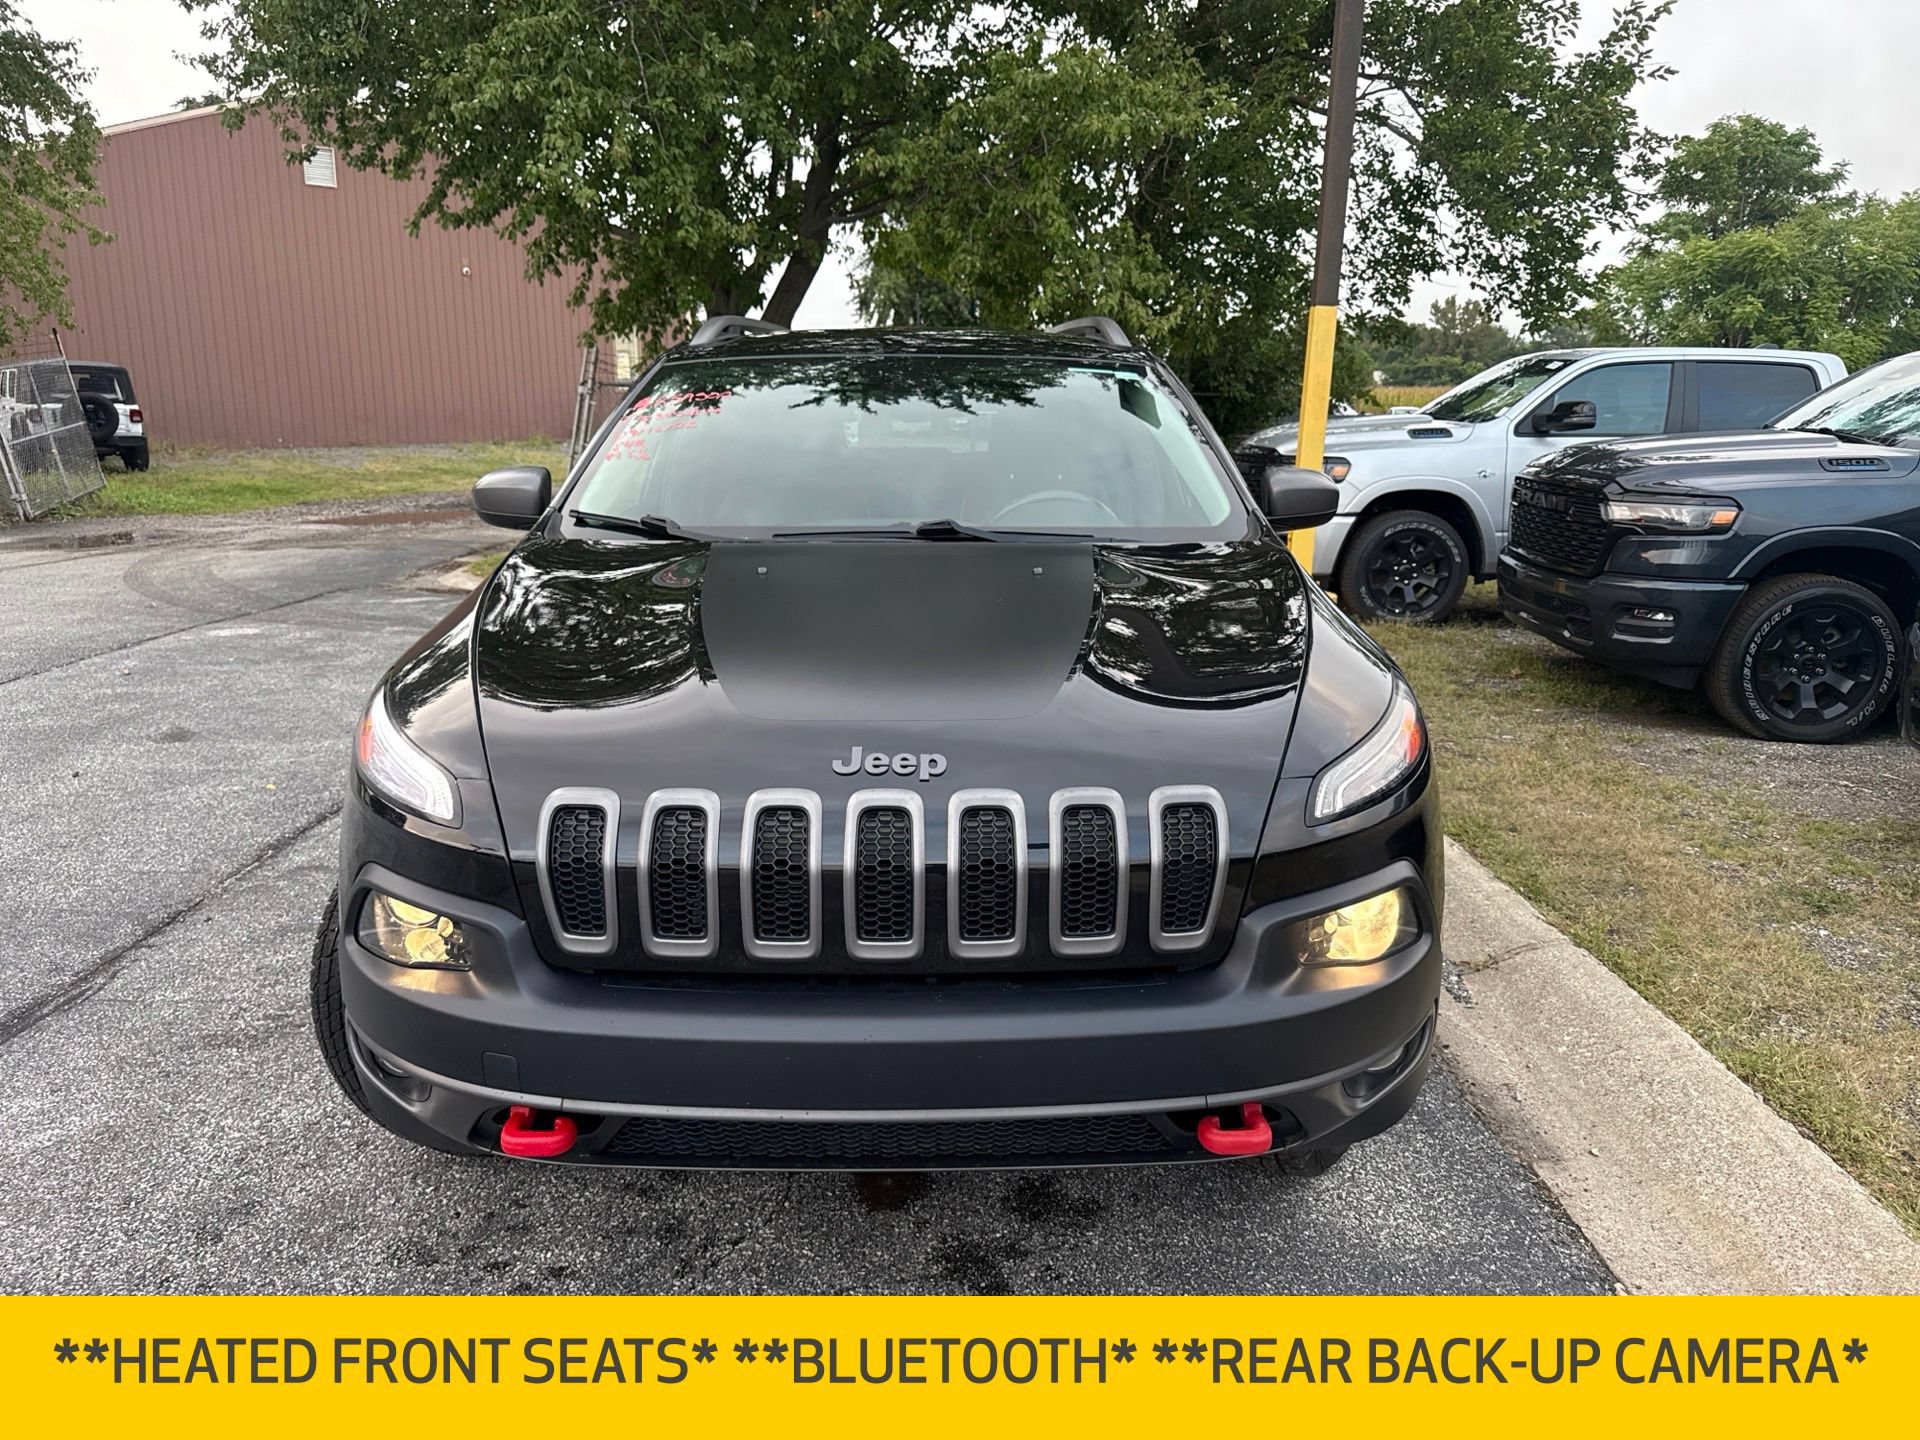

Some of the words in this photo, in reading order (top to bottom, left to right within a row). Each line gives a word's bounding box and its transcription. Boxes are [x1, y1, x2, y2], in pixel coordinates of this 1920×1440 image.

[1520, 488, 1569, 512] RAM
[1742, 604, 1793, 721] BRIDGESTONE
[1871, 615, 1898, 694] DUELER
[832, 746, 947, 781] Jeep
